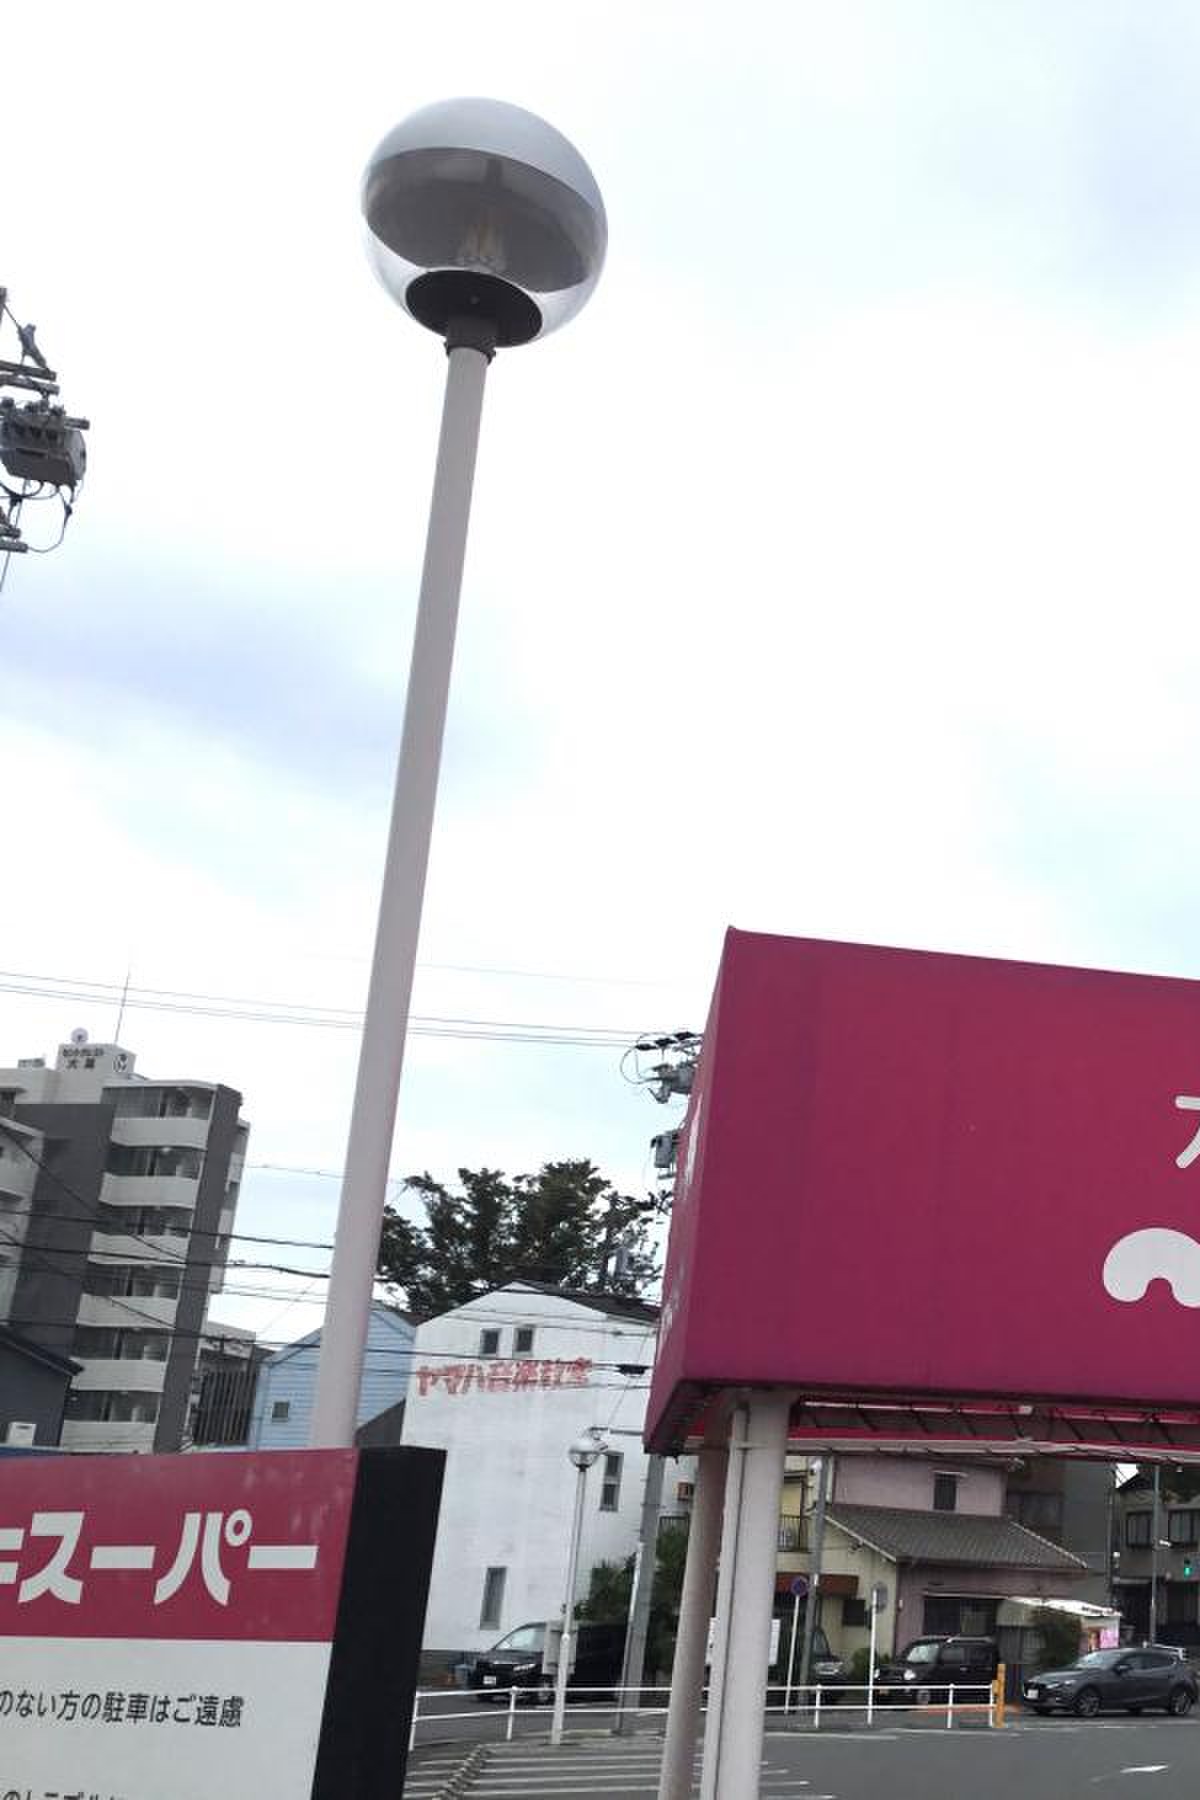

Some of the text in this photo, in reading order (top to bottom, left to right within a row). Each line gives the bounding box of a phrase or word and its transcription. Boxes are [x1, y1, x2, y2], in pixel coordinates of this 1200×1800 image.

[0, 1689, 244, 1728] のない方の駐車はご遠慮
